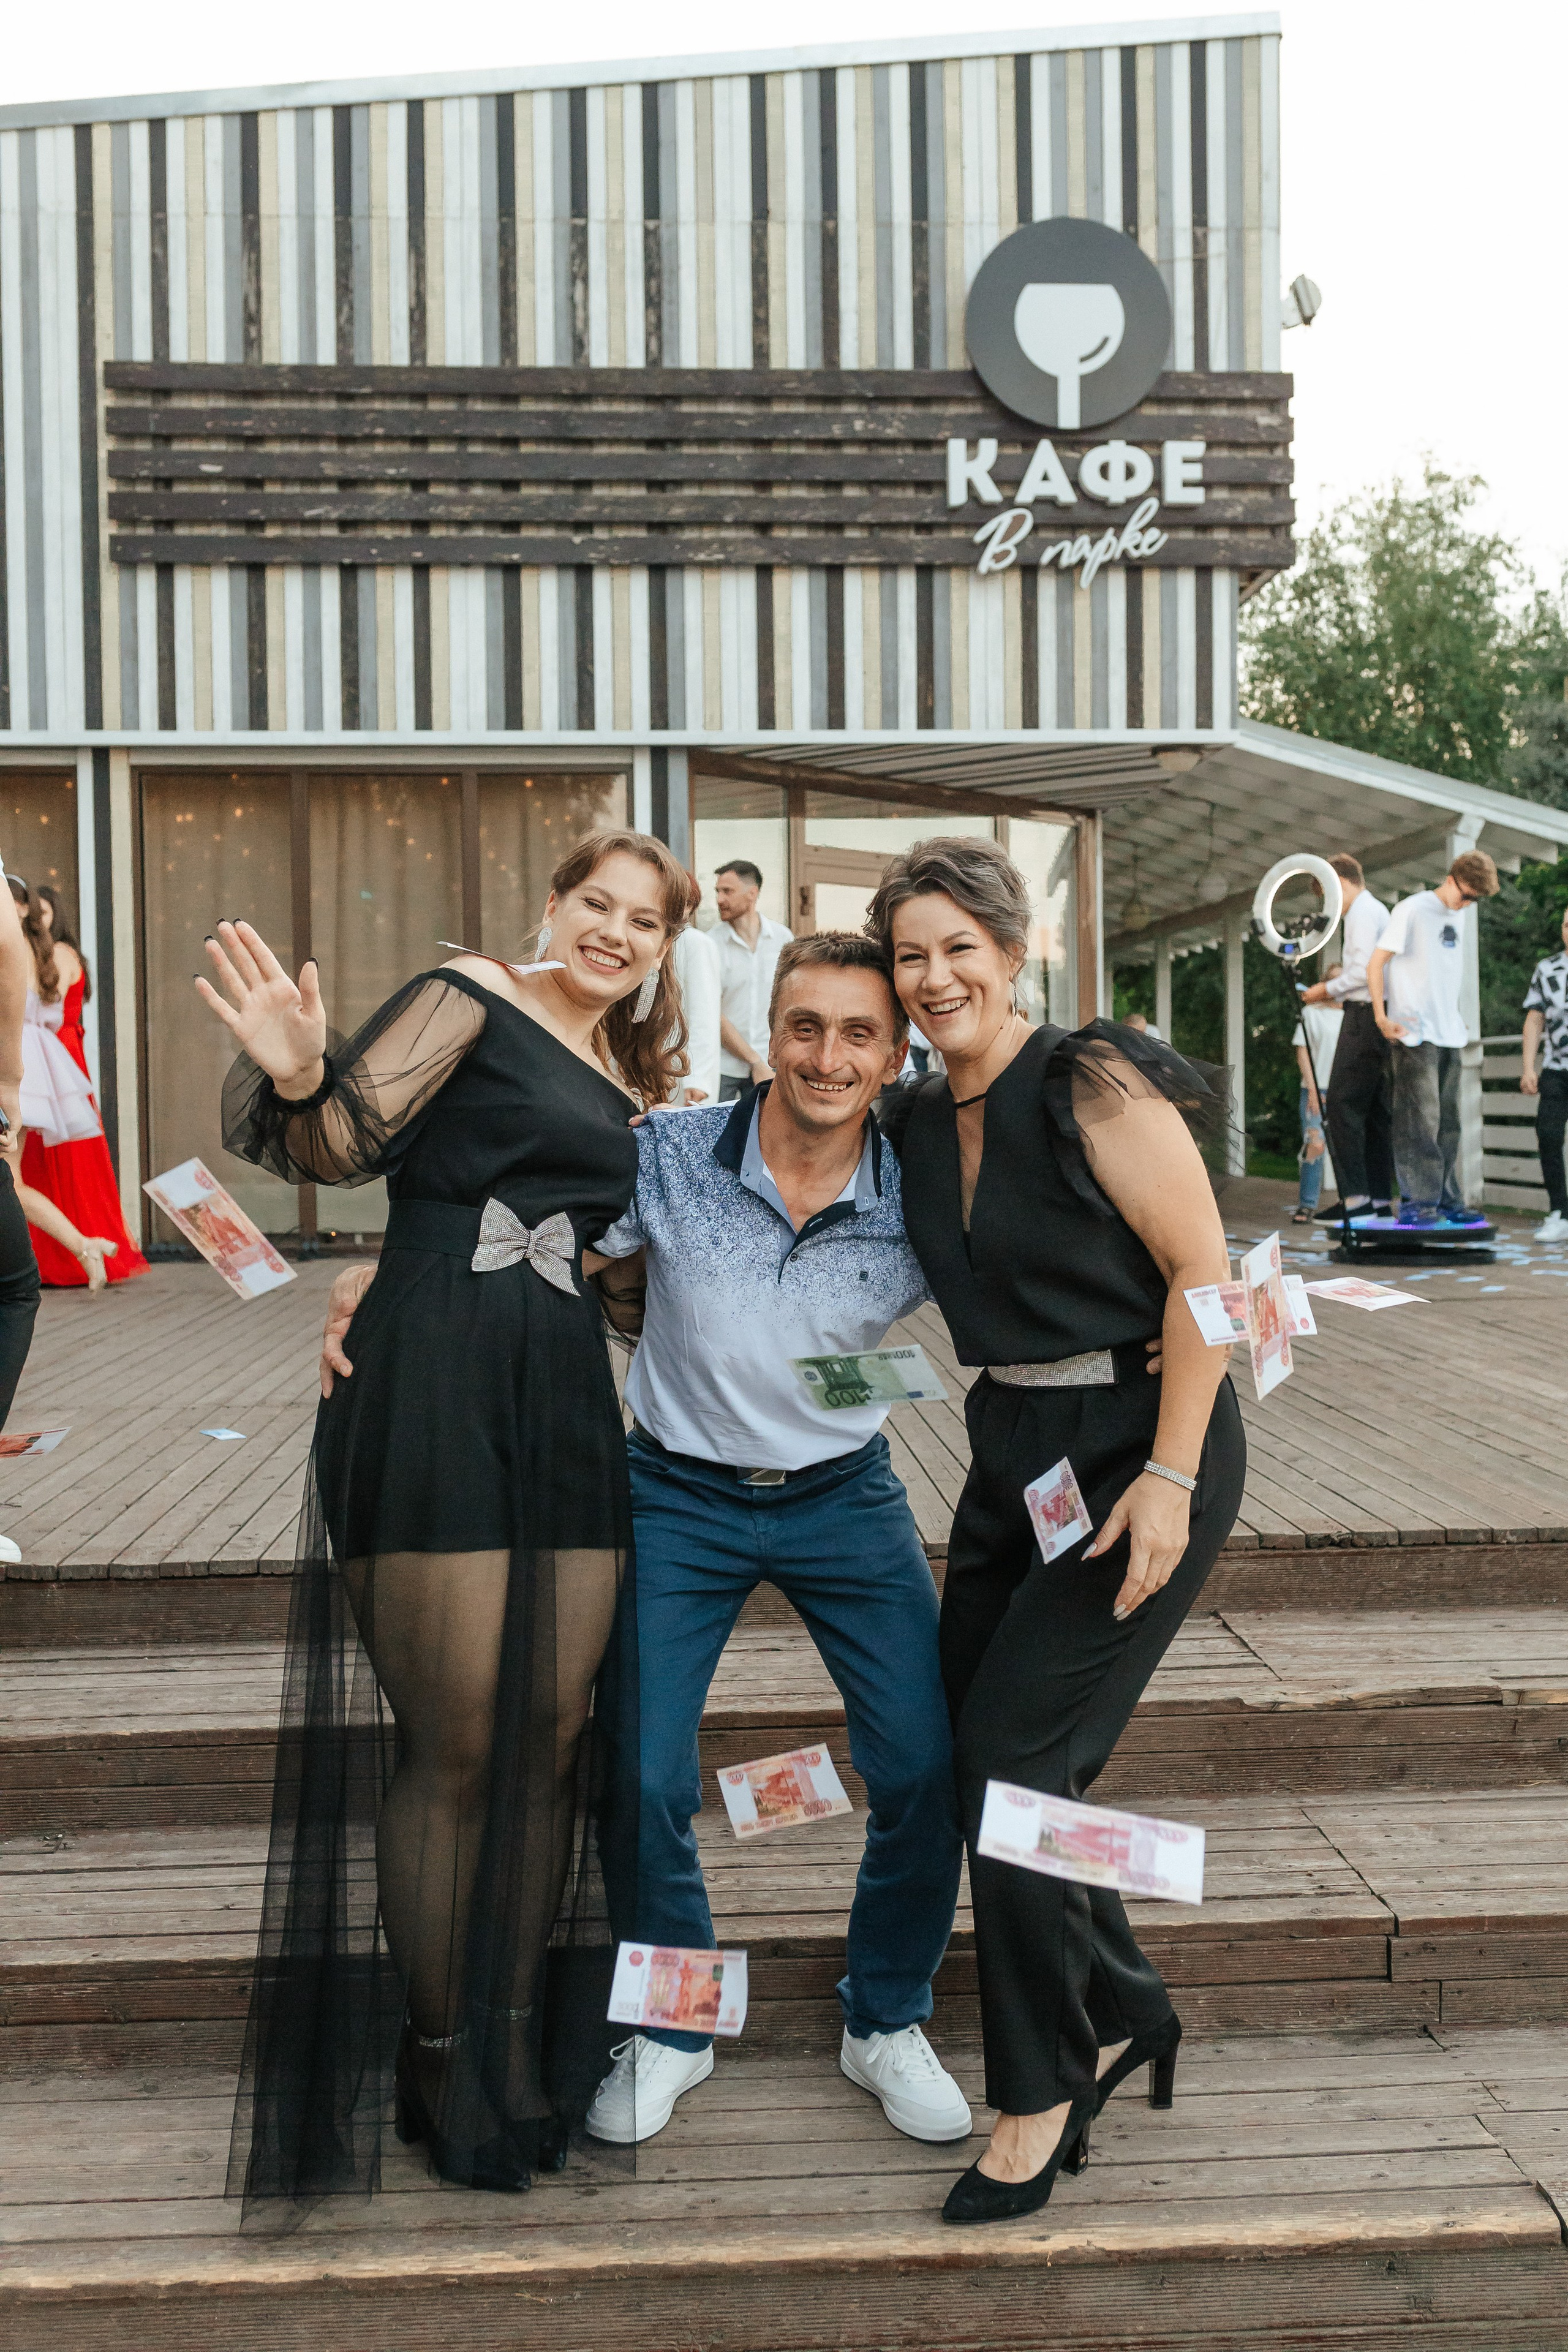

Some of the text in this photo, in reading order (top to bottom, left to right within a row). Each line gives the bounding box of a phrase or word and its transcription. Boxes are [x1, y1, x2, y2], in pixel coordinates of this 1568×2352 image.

[947, 437, 1206, 507] КАФЕ
[973, 496, 1169, 589] В парке
[824, 1389, 872, 1407] 100
